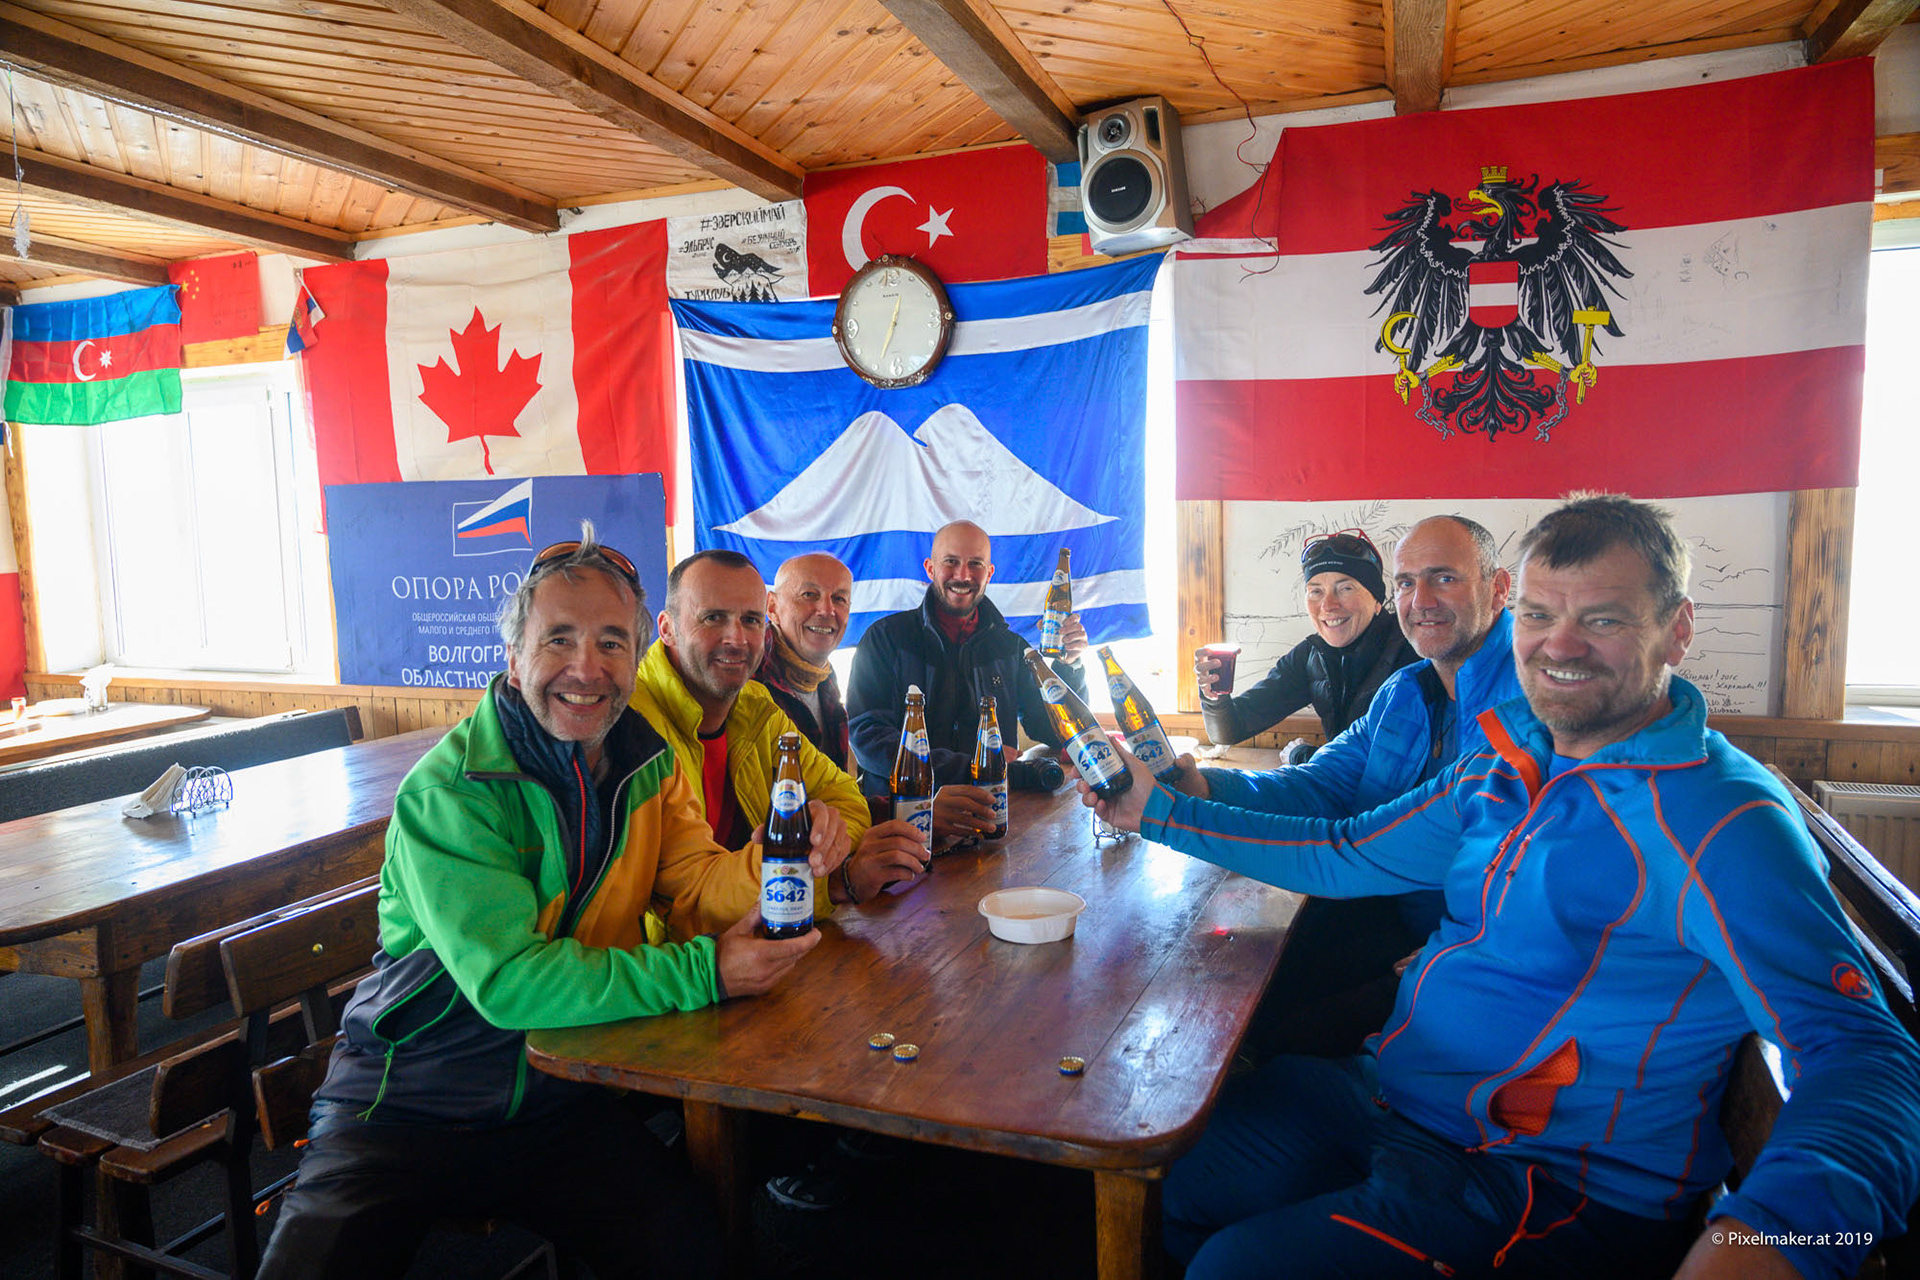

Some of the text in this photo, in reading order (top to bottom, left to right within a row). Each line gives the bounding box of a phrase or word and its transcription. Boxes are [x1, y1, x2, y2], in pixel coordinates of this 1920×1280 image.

[846, 318, 859, 339] 9
[889, 357, 903, 377] 6
[392, 575, 483, 600] ОПОРА
[412, 612, 476, 622] ОБЩЕРОССИЙСКАЯ
[418, 625, 448, 635] МАЛОГО
[449, 626, 454, 635] И
[455, 625, 490, 636] СРЕДНЕГО
[1081, 746, 1112, 771] 5642
[766, 889, 806, 903] 5642
